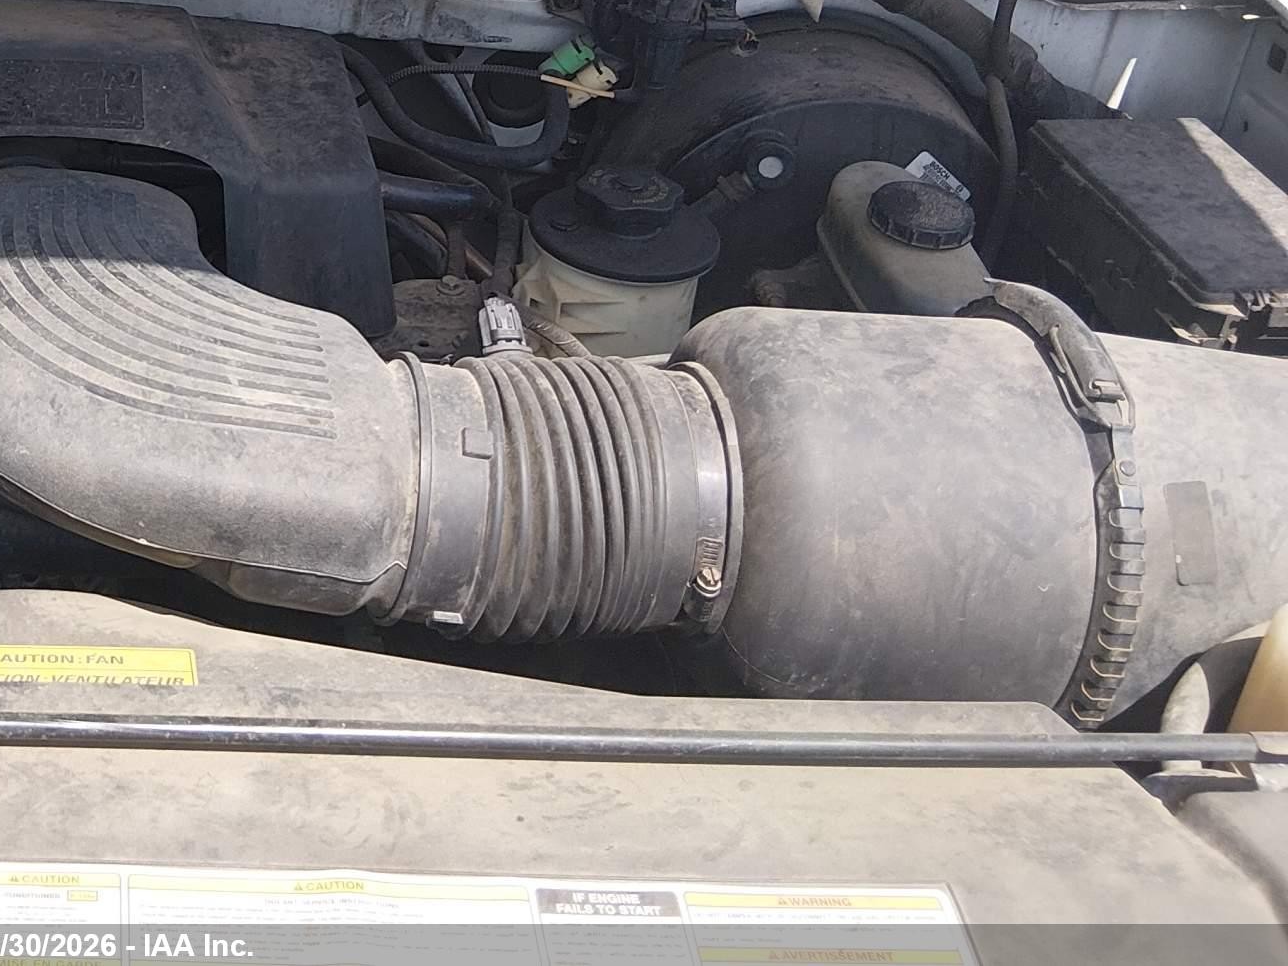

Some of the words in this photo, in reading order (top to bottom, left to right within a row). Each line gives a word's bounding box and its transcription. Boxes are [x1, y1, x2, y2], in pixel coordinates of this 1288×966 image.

[21, 874, 80, 884] CAUTION
[305, 881, 365, 891] CAUTION
[571, 892, 584, 904] IF
[588, 893, 641, 904] ENGINE
[791, 897, 853, 907] WARNING
[556, 903, 594, 914] FAILS
[595, 904, 617, 915] TO
[619, 905, 662, 916] START
[782, 949, 896, 962] AVERTISSEMENT
